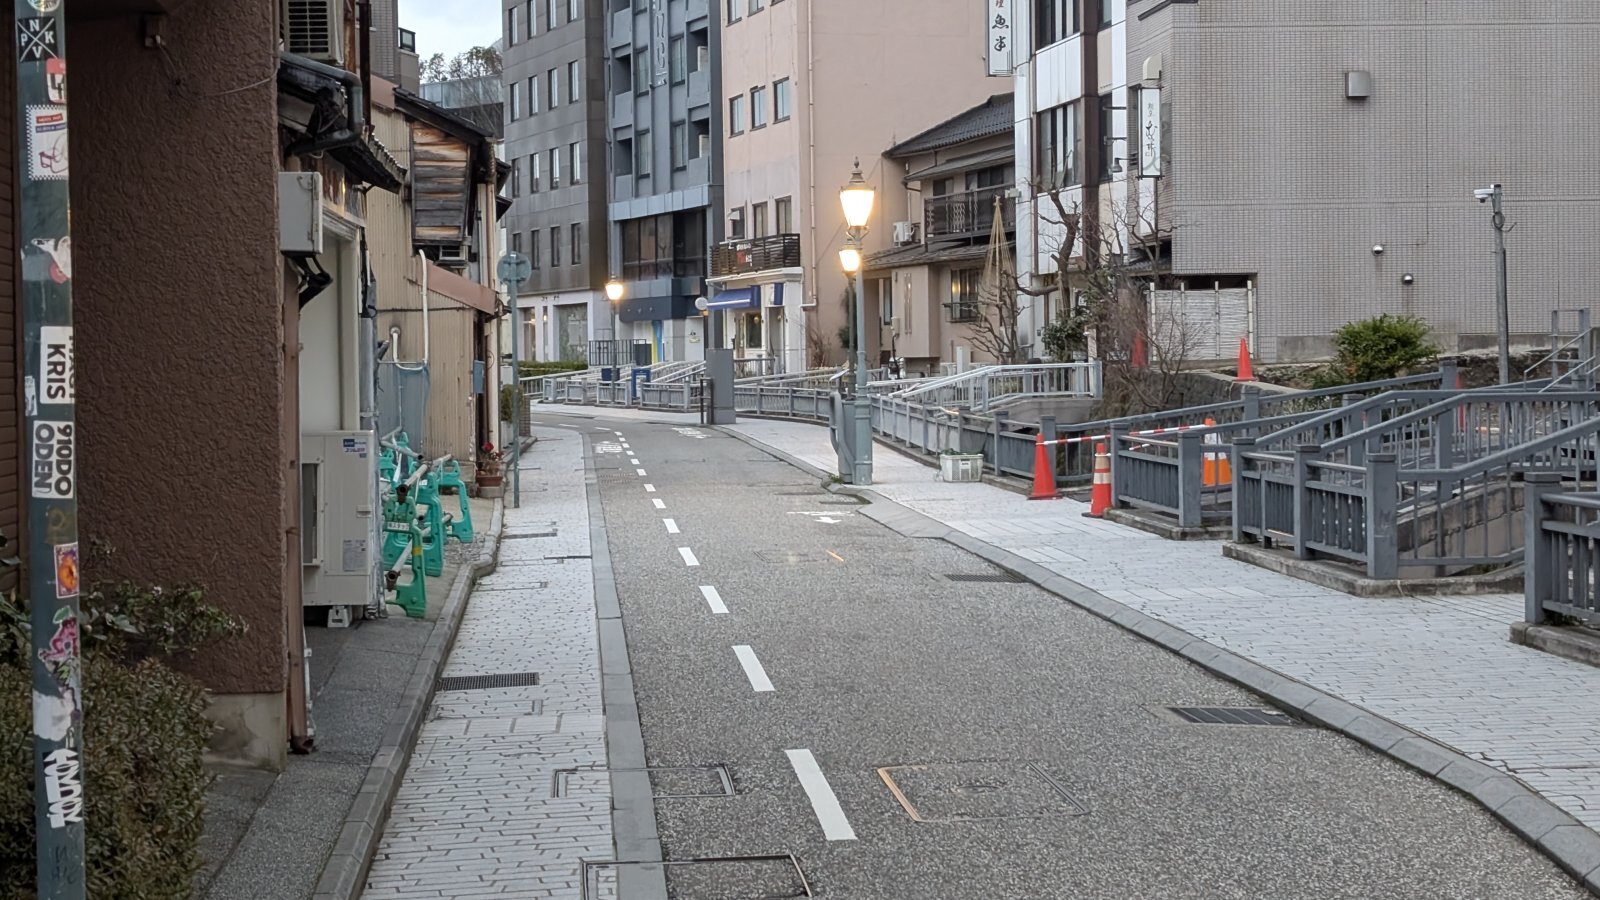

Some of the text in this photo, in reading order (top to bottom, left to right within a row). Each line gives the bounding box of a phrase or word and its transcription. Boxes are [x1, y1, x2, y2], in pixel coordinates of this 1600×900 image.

[29, 19, 40, 32] N
[20, 34, 28, 46] P
[44, 31, 55, 44] K
[32, 47, 43, 59] V
[46, 343, 66, 399] KRIS
[34, 423, 55, 489] ODEN
